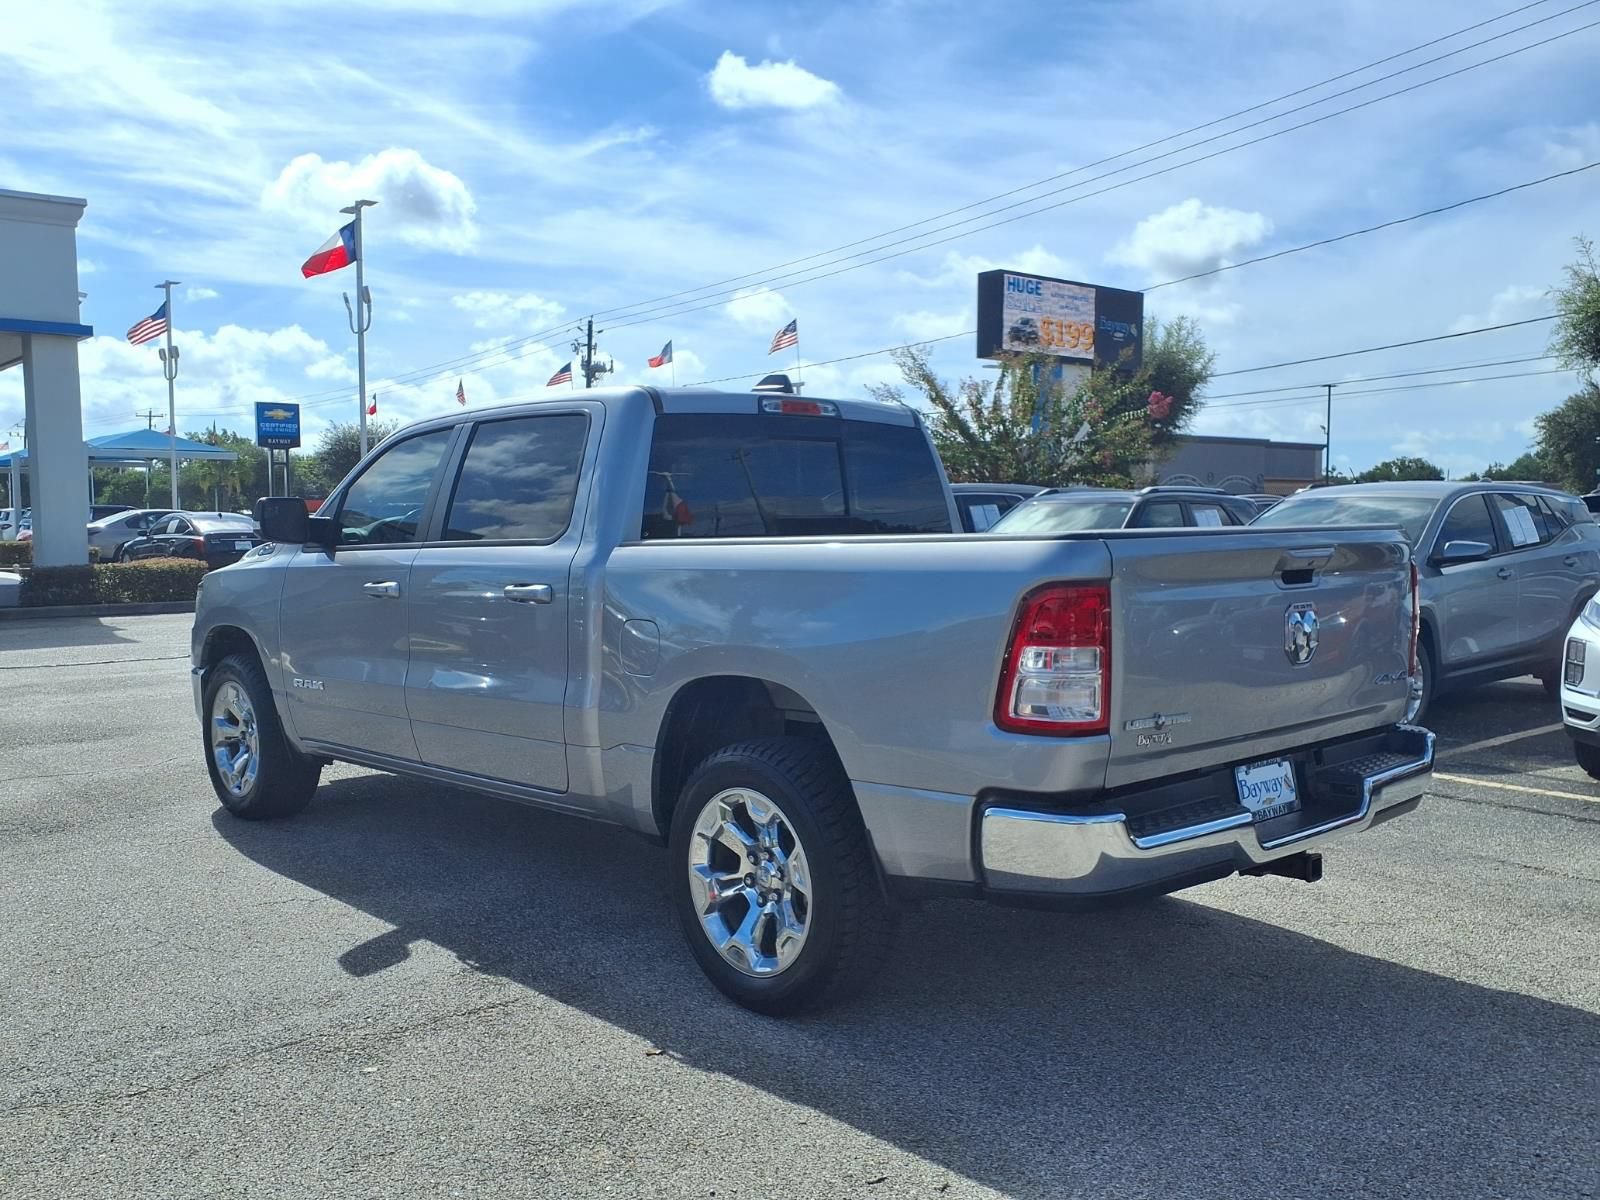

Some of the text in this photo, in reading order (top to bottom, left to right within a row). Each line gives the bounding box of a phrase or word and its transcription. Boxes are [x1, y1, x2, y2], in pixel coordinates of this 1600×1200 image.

[1007, 276, 1042, 296] HUGE
[1040, 315, 1094, 350] $199
[293, 678, 325, 690] RAM
[1239, 776, 1283, 804] Bayway
[1257, 802, 1289, 820] BAYWAY
